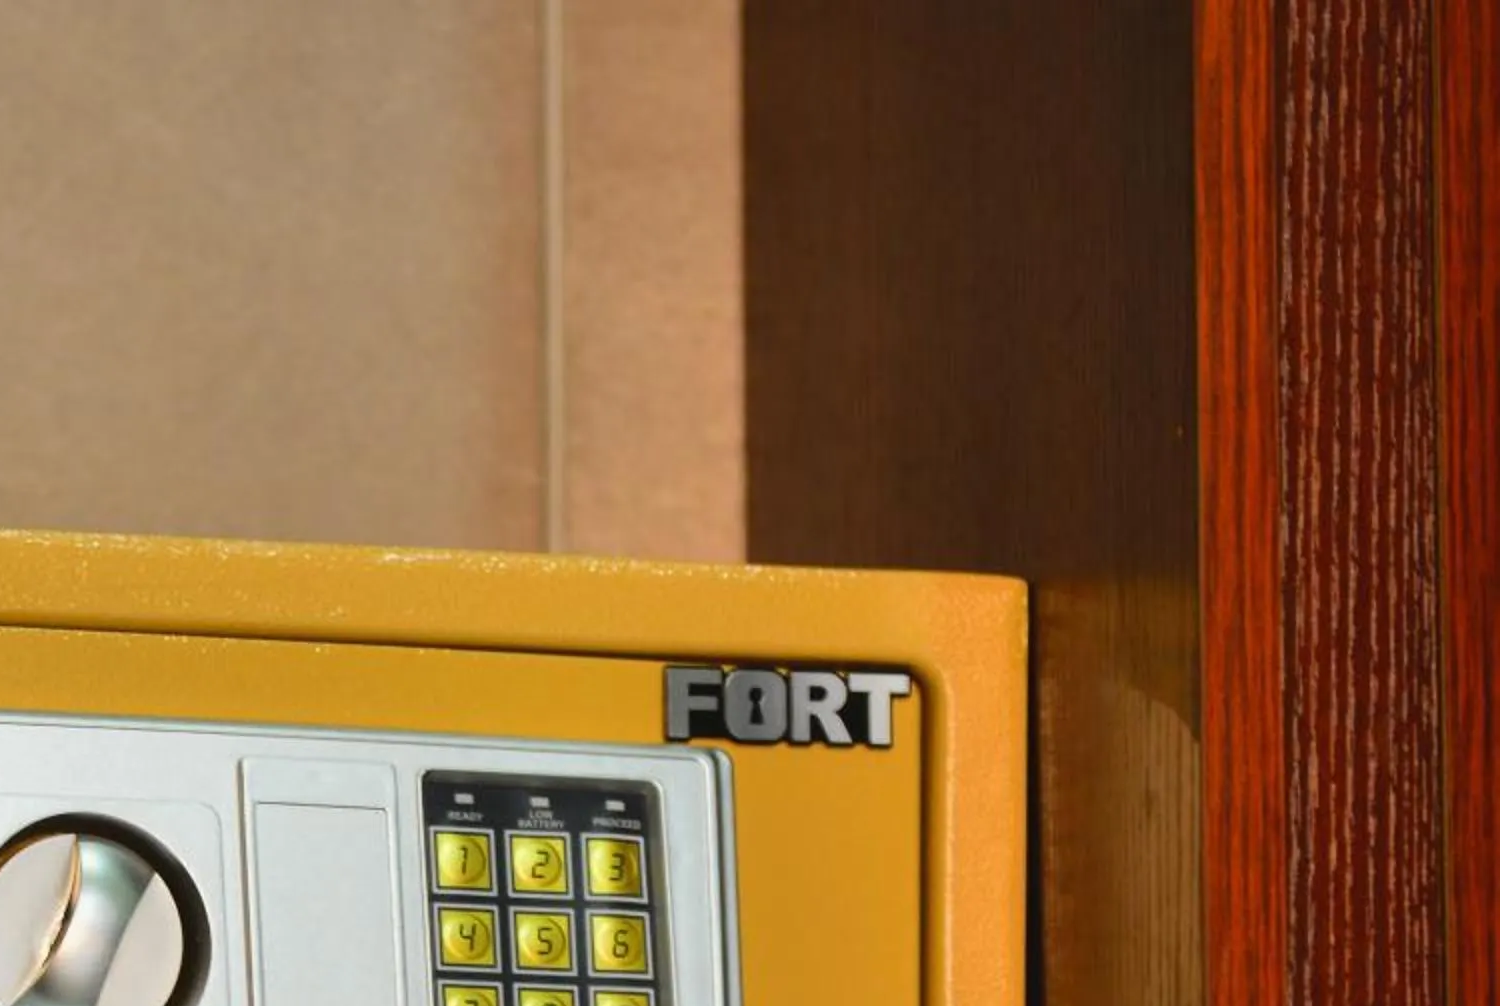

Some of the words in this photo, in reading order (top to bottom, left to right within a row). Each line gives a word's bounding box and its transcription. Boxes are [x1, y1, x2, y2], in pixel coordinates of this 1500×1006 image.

[666, 667, 911, 745] FORT
[447, 811, 483, 821] READY
[517, 818, 565, 829] BATTERY
[529, 810, 553, 819] LOW
[530, 850, 549, 879] 2
[609, 852, 625, 881] 3
[459, 922, 477, 952] 4
[536, 927, 553, 956] 5
[612, 929, 629, 959] 6
